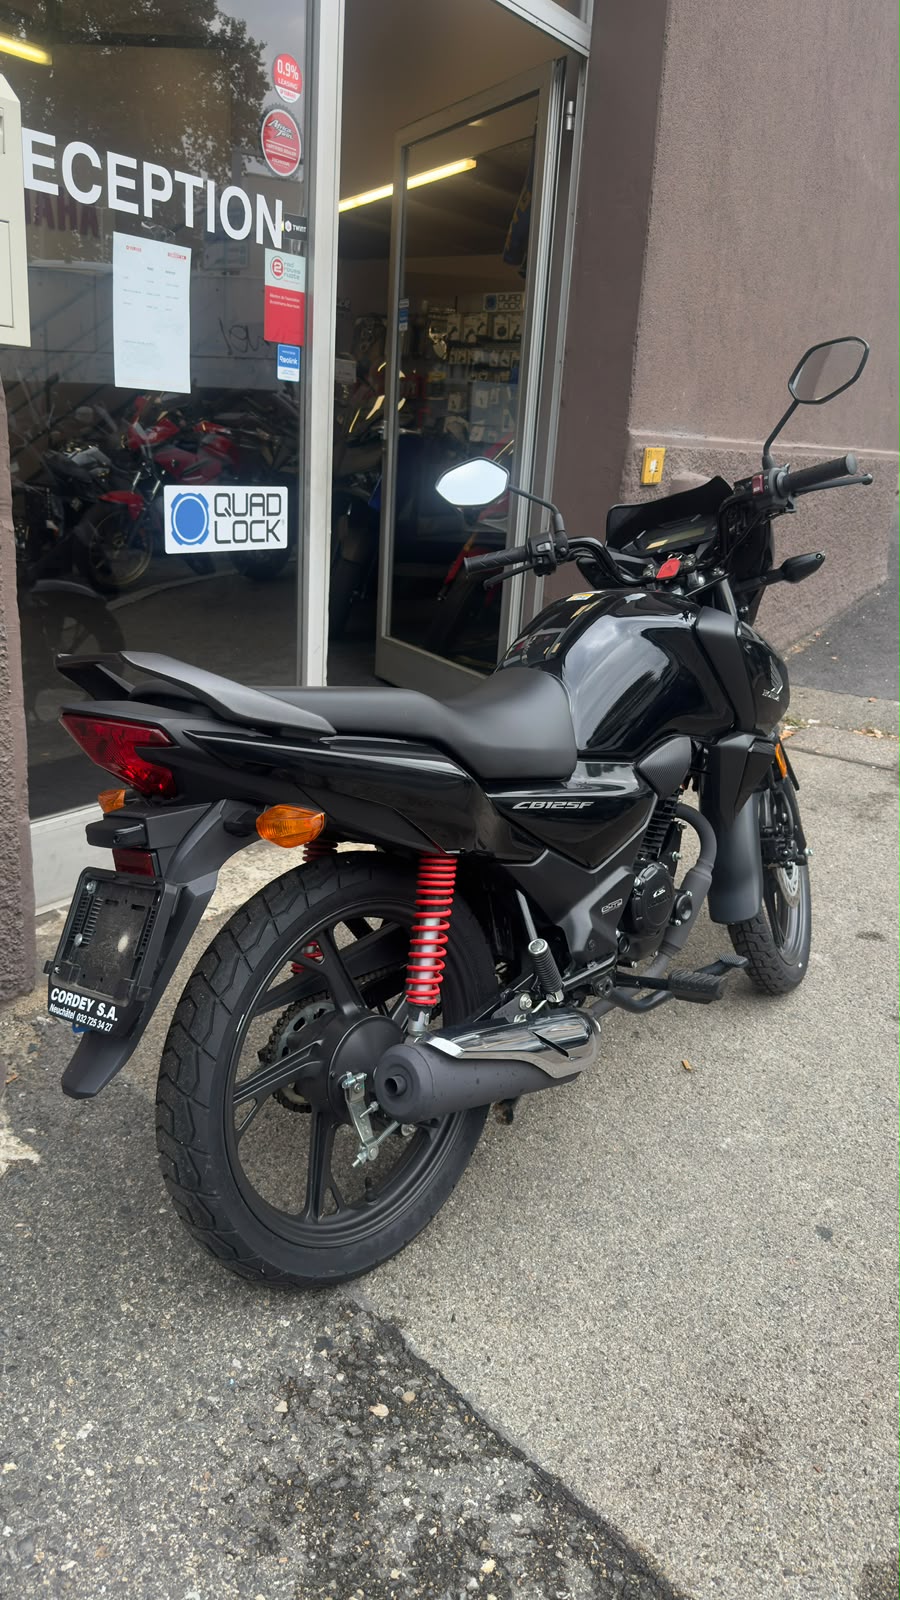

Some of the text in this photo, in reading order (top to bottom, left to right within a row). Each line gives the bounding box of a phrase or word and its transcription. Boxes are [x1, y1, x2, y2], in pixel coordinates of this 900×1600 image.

[277, 59, 299, 81] 0.9%
[277, 78, 298, 90] LEASING
[214, 492, 282, 518] QUAD
[214, 519, 281, 544] LOCK
[512, 801, 594, 810] CB125F
[49, 1003, 113, 1032] Neuchâtel 032 725 34 27
[50, 988, 118, 1022] CORDEY S.A.
